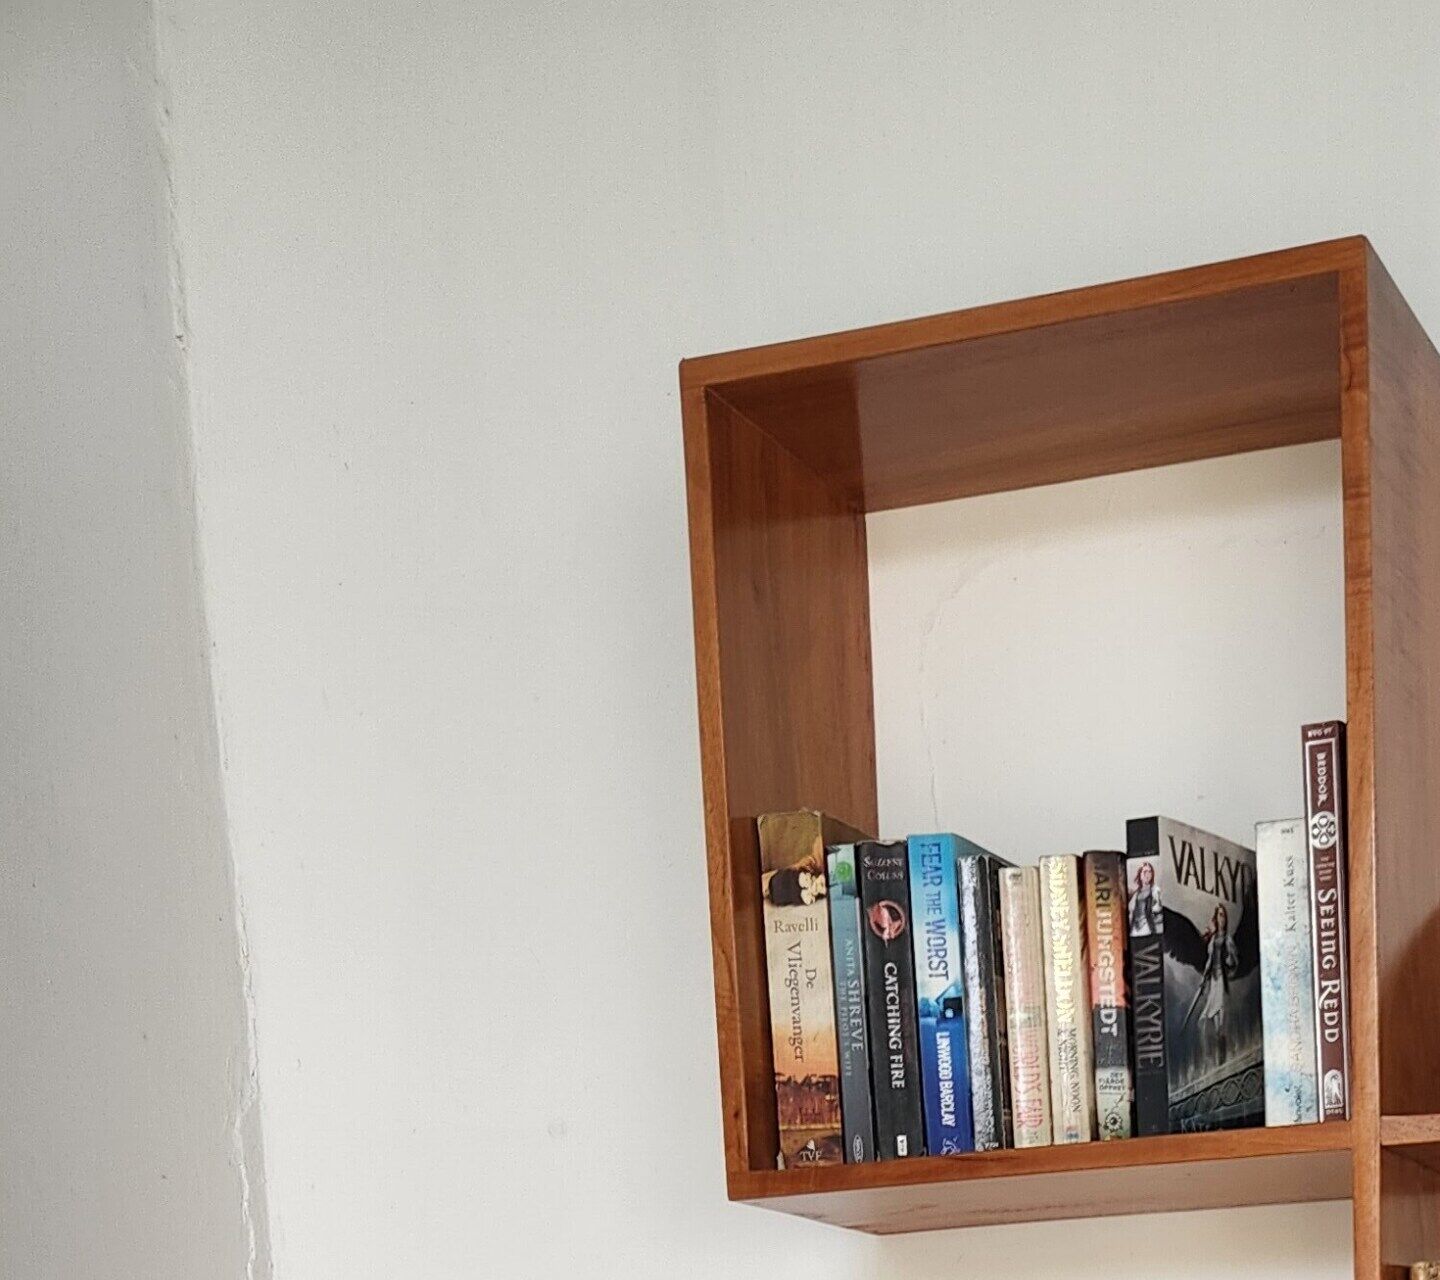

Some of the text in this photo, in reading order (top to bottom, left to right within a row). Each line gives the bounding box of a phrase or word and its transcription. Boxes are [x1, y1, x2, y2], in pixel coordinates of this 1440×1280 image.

[1316, 752, 1328, 807] BEDDOR
[773, 916, 820, 935] Ravelli
[921, 843, 949, 981] FEAR THE WORST
[1096, 909, 1118, 1037] JUNGSTEDT
[1318, 889, 1340, 1043] SEEING REDD
[784, 939, 808, 1063] Vliegenvanger
[804, 967, 818, 990] De
[847, 979, 864, 1052] SHREVE
[883, 962, 905, 1090] CATCHING FIRE
[1134, 941, 1164, 1070] VALKYRIE
[936, 1031, 955, 1127] LINWOOD BARCLAY
